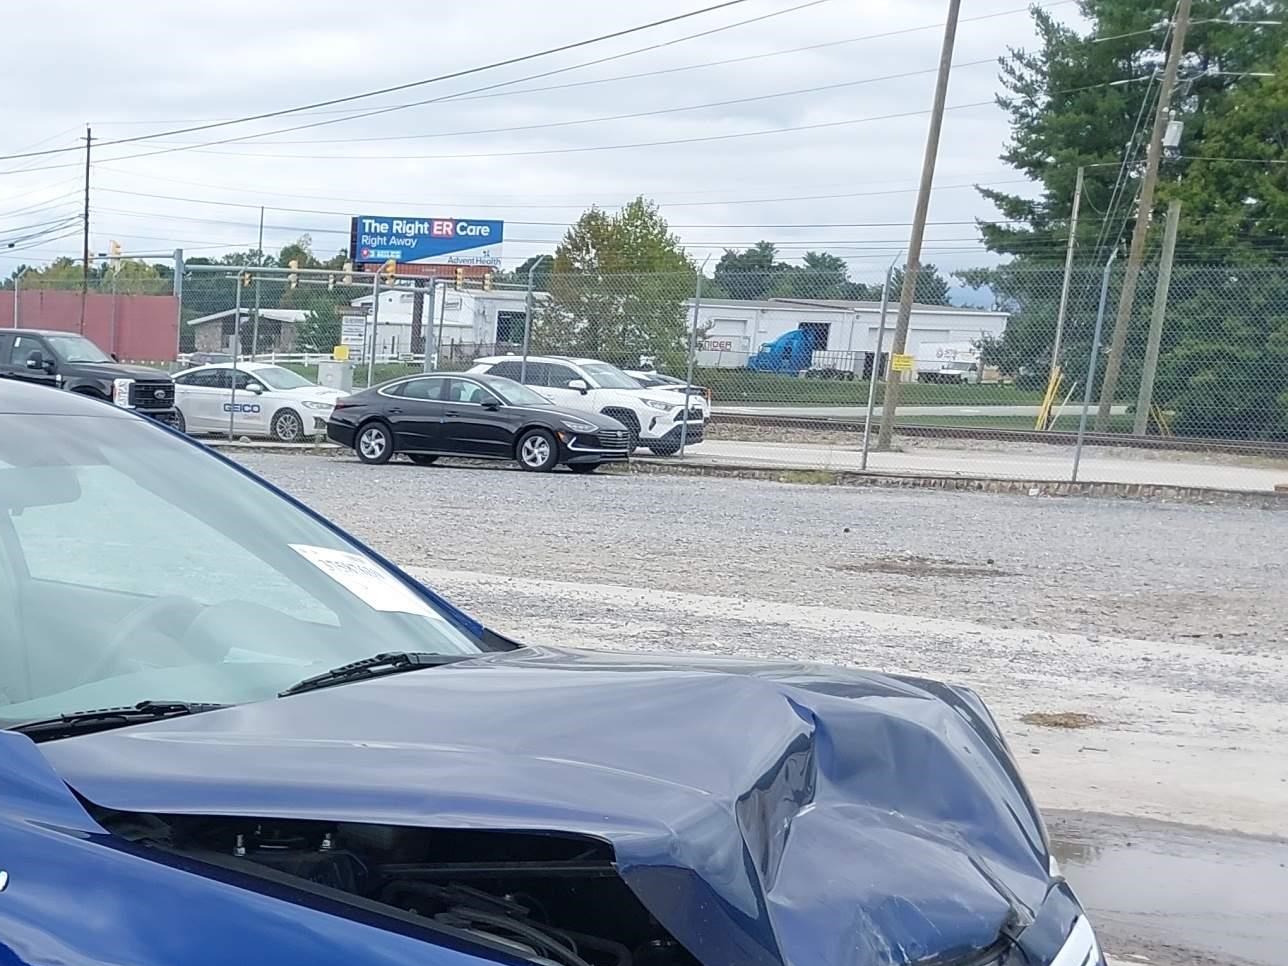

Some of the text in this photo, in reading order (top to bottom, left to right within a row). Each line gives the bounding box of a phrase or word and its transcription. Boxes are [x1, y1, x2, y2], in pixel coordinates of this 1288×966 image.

[363, 220, 490, 236] The Right ER Care
[361, 235, 418, 248] Right Away
[223, 403, 261, 413] GEICO
